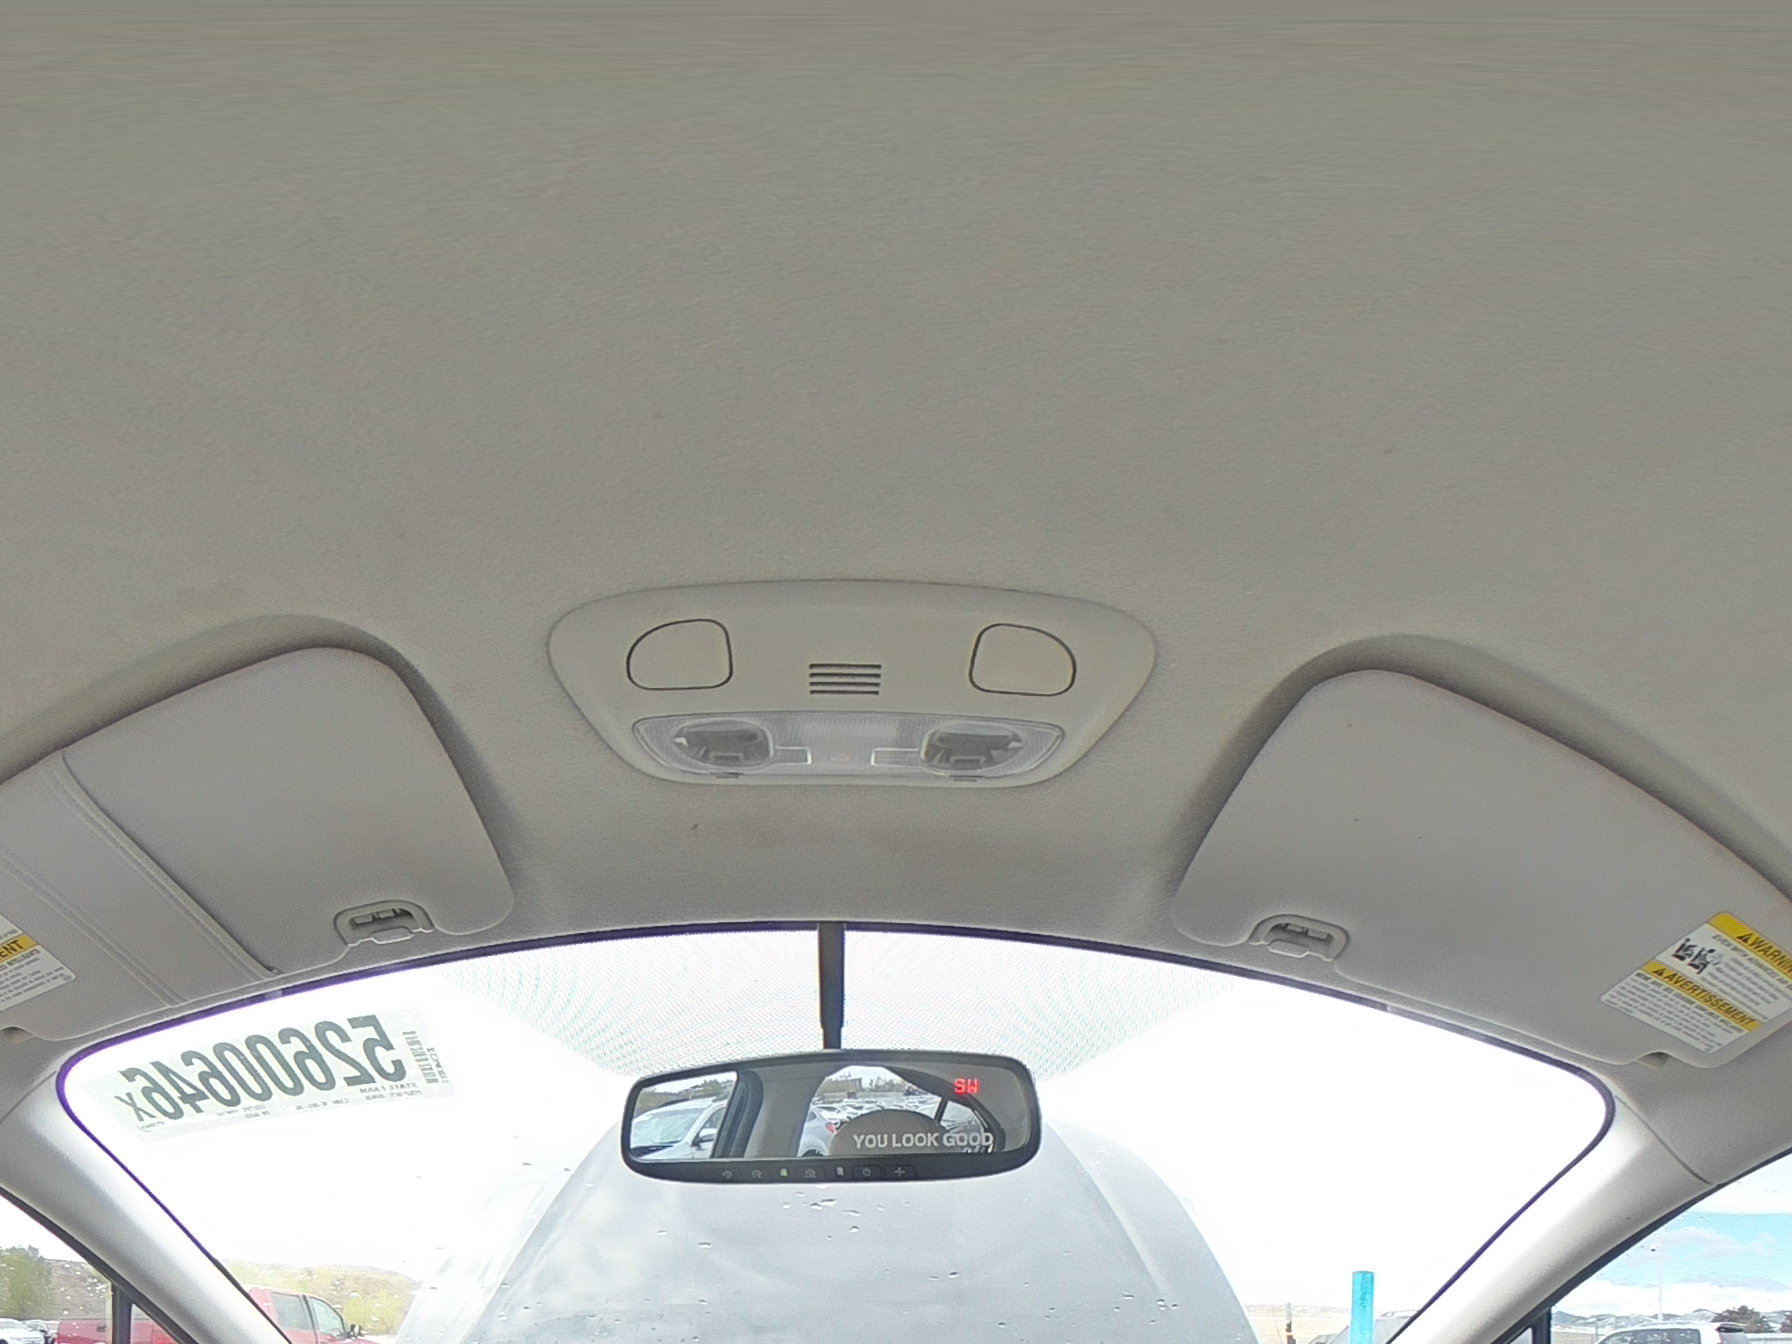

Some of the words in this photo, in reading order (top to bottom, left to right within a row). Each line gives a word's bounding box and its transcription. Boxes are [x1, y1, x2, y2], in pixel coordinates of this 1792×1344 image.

[1663, 970, 1757, 1027] AVERTISSEMENT
[852, 1133, 889, 1149] YOU
[892, 1132, 940, 1147] LOOK
[942, 1131, 994, 1147] GOOD
